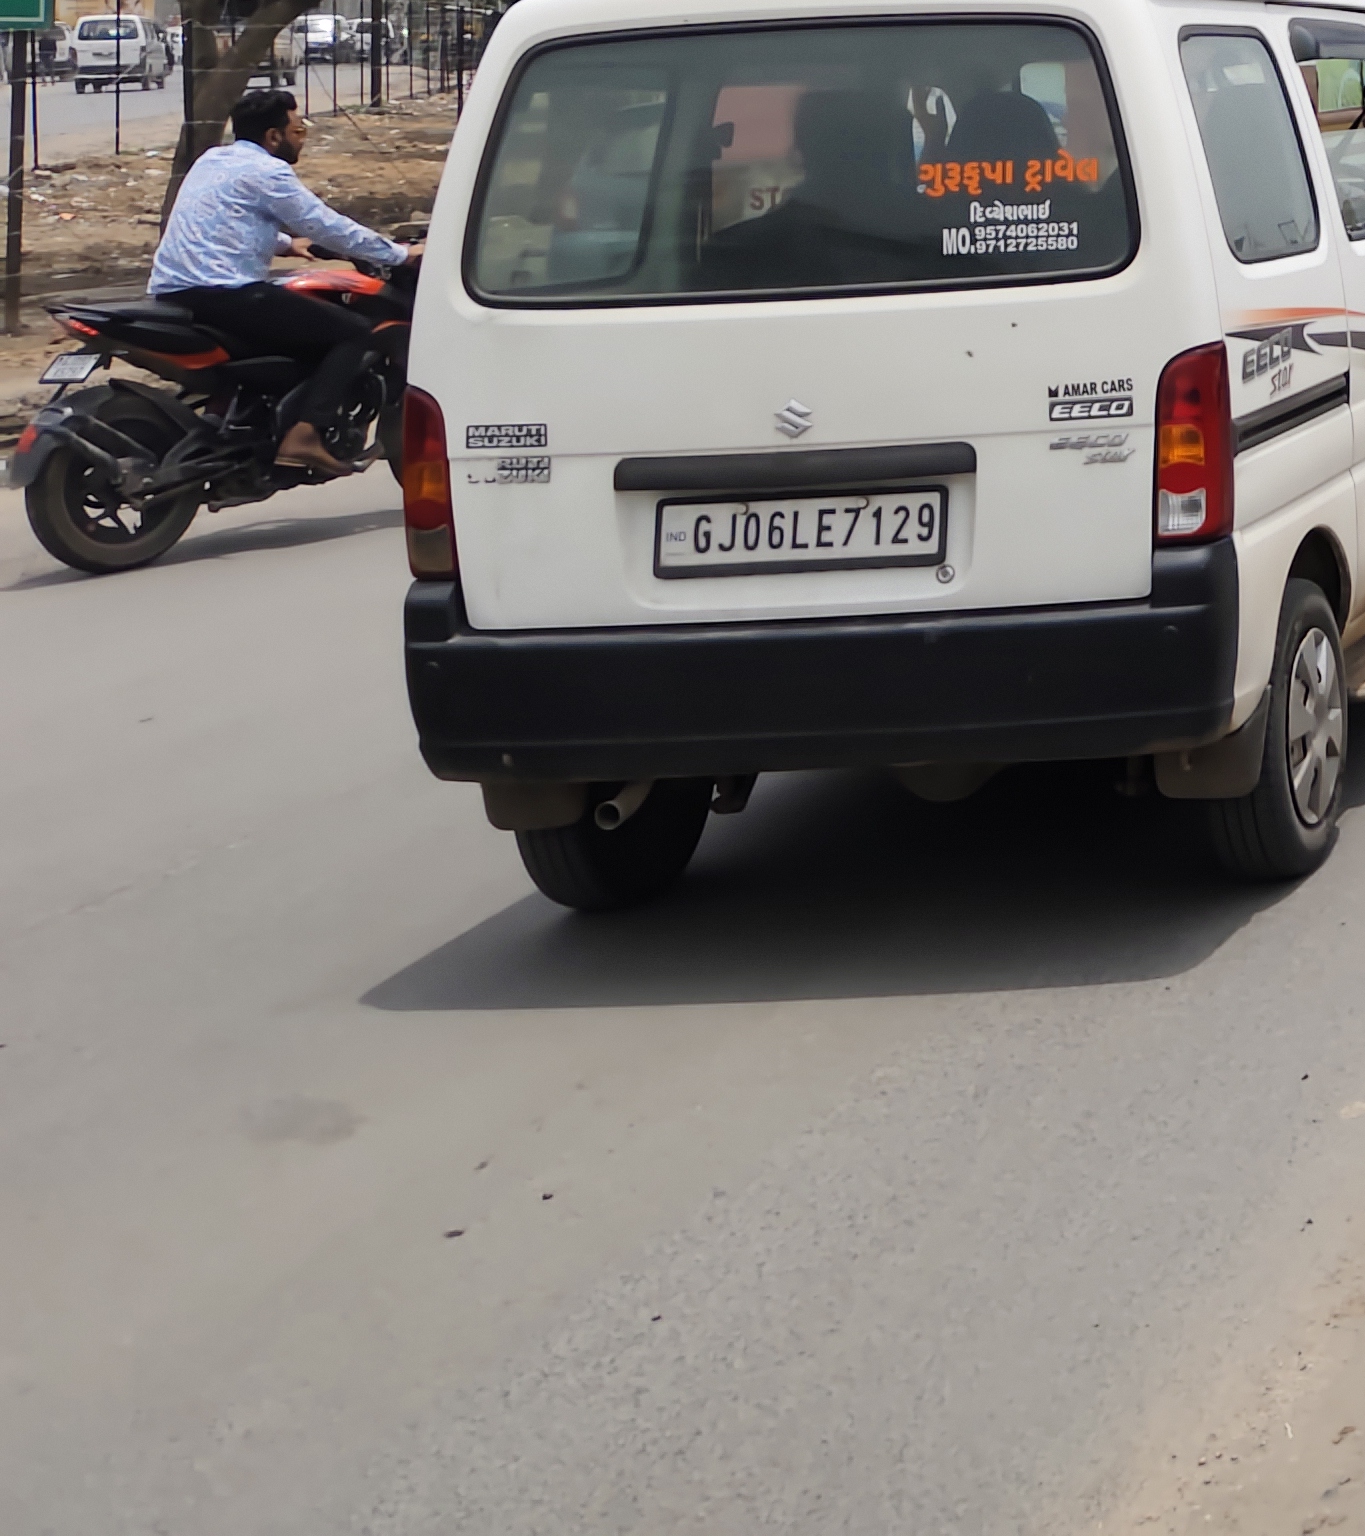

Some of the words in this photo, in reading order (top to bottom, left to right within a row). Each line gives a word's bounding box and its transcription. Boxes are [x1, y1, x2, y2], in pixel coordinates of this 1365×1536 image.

[1024, 148, 1098, 192] ટ્રાવેલ
[942, 227, 975, 255] MO.
[975, 221, 1078, 240] 9574062031
[975, 237, 1078, 254] 9712725580
[1241, 327, 1293, 384] EECO
[1063, 382, 1097, 398] AMAR
[1101, 378, 1133, 394] CARS
[1051, 400, 1131, 418] EECO
[468, 435, 546, 447] SUZUKI
[469, 425, 545, 437] MARUTI
[665, 531, 687, 542] IND
[694, 502, 936, 554] GJ06LE7129
